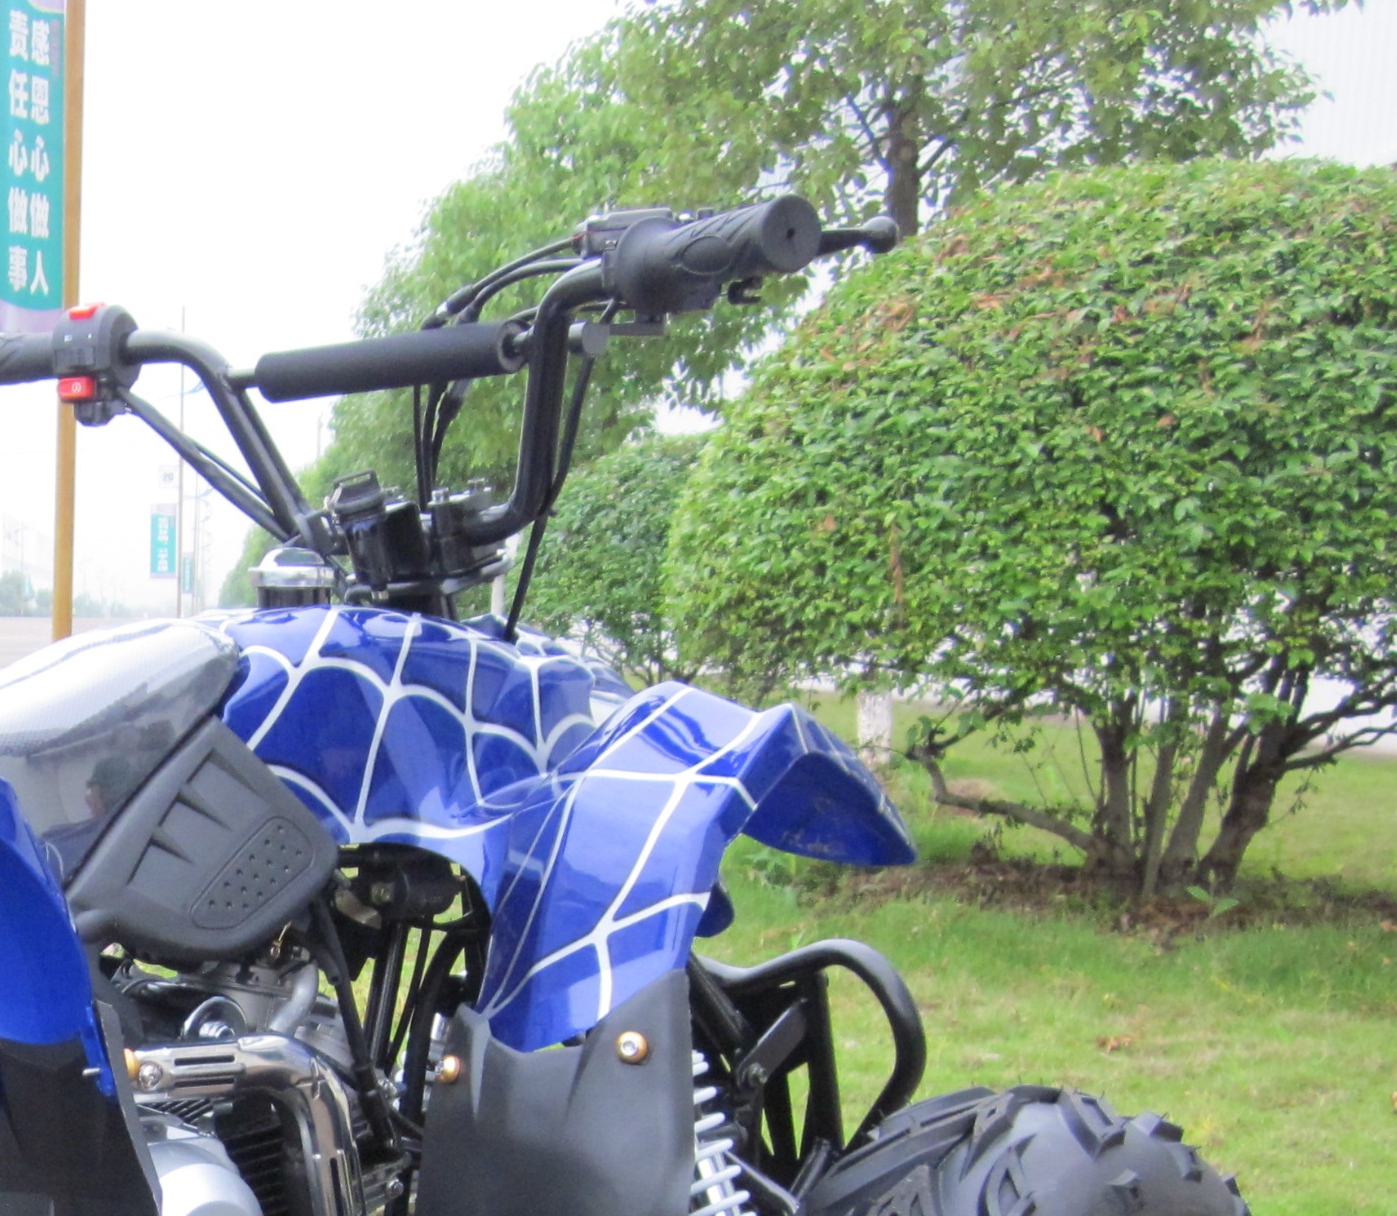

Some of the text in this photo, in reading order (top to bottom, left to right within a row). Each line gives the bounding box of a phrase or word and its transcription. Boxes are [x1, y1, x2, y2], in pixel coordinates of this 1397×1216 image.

[8, 9, 29, 293] 责任心做事
[30, 19, 51, 296] 感恩心做人
